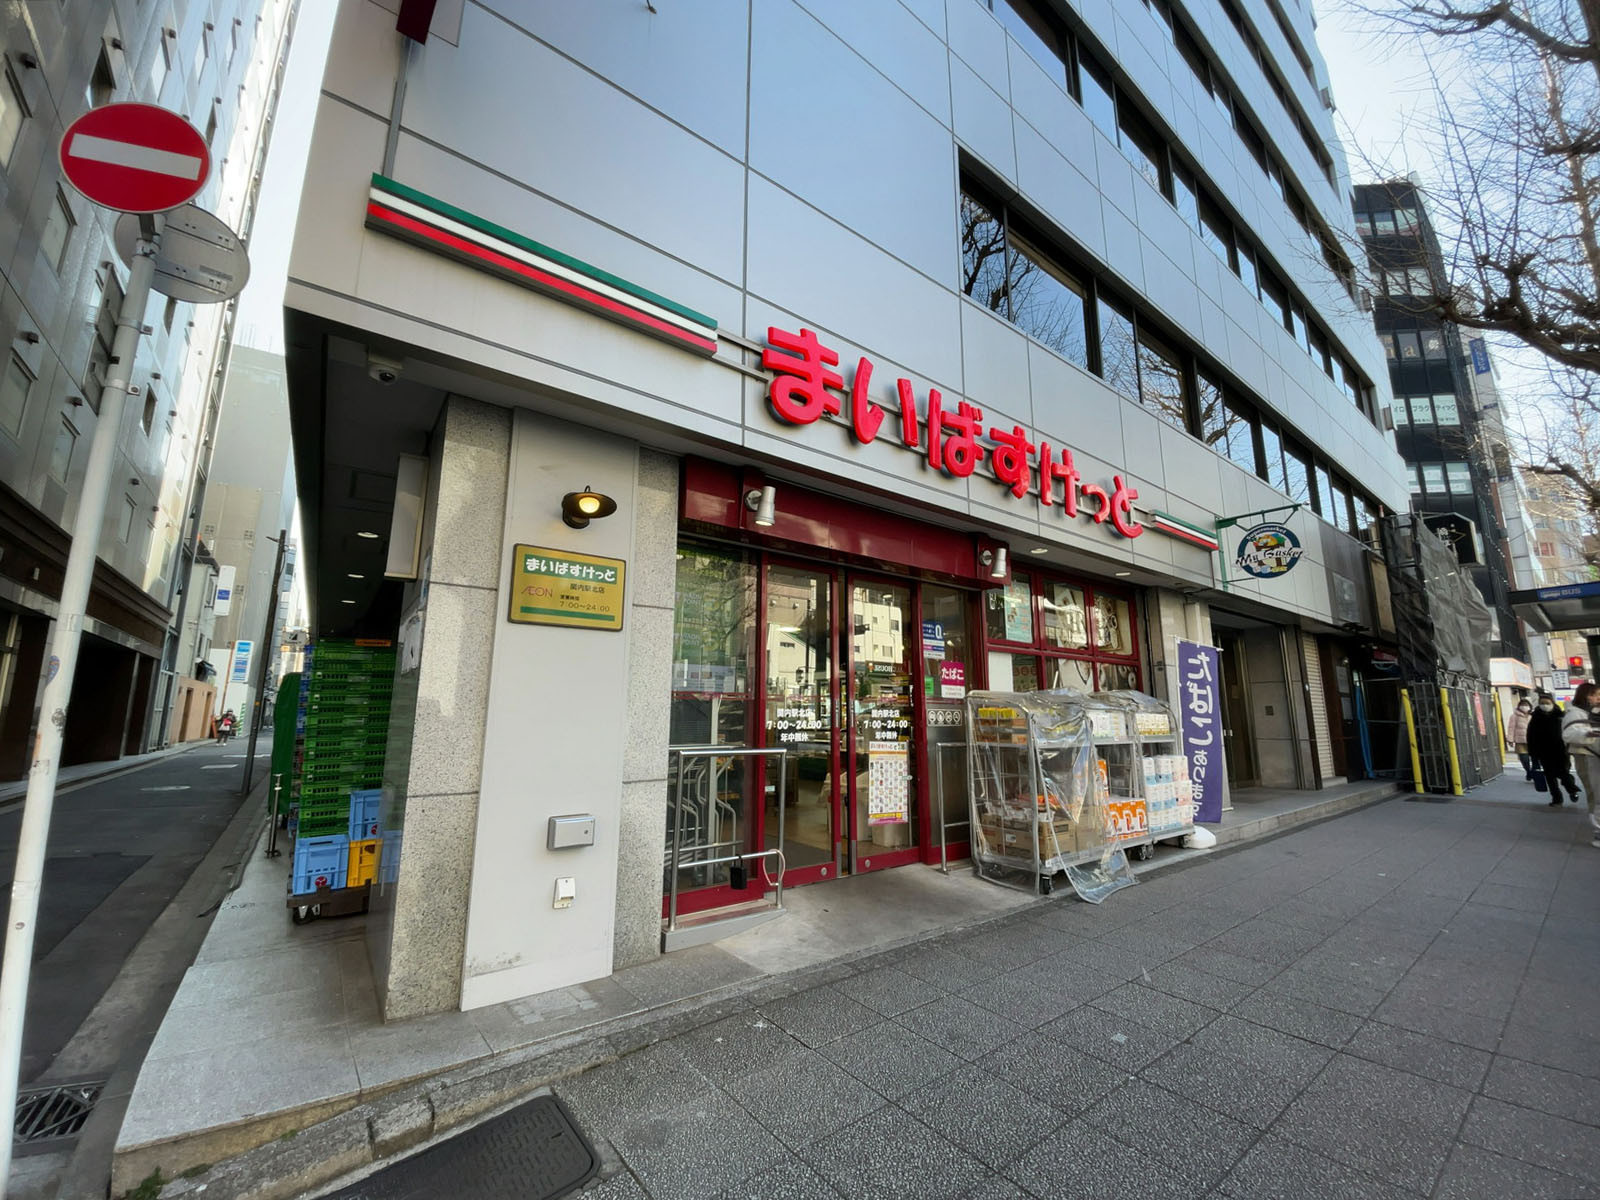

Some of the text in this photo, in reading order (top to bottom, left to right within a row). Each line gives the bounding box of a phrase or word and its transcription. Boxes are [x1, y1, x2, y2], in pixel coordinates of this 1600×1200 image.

[762, 326, 1143, 539] まいばすけっと
[1235, 553, 1259, 566] My
[526, 558, 615, 582] まいばすけっと
[941, 666, 964, 681] たばこ
